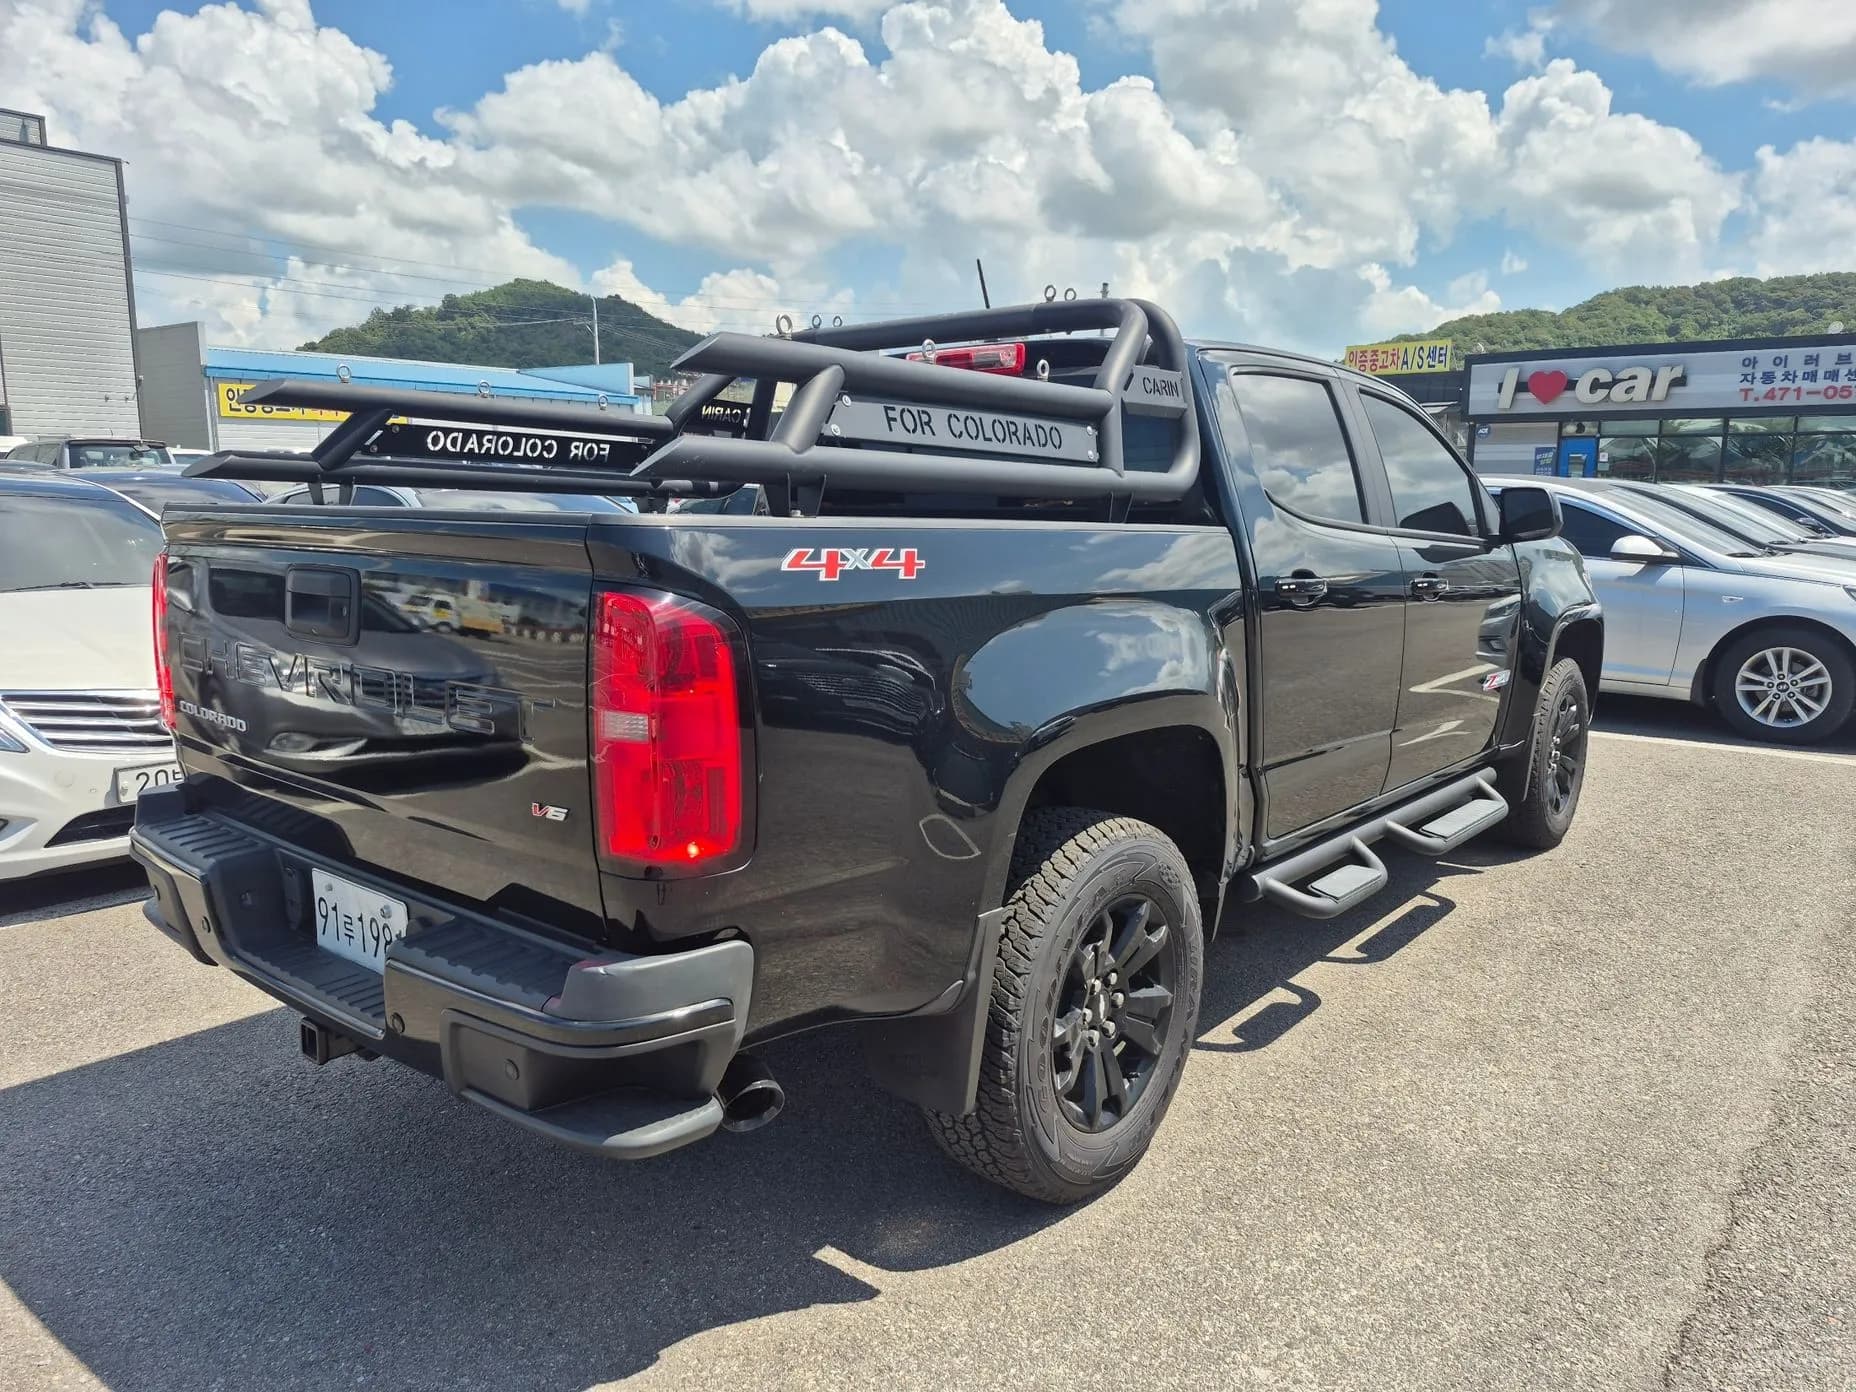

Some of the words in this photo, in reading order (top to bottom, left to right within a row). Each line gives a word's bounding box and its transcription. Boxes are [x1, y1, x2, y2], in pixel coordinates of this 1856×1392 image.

[1142, 377, 1179, 397] CARIN
[1575, 364, 1684, 403] car
[883, 404, 934, 436] FOR
[947, 415, 1063, 450] COLORADO
[179, 699, 248, 733] COLORADO
[531, 802, 569, 822] V6
